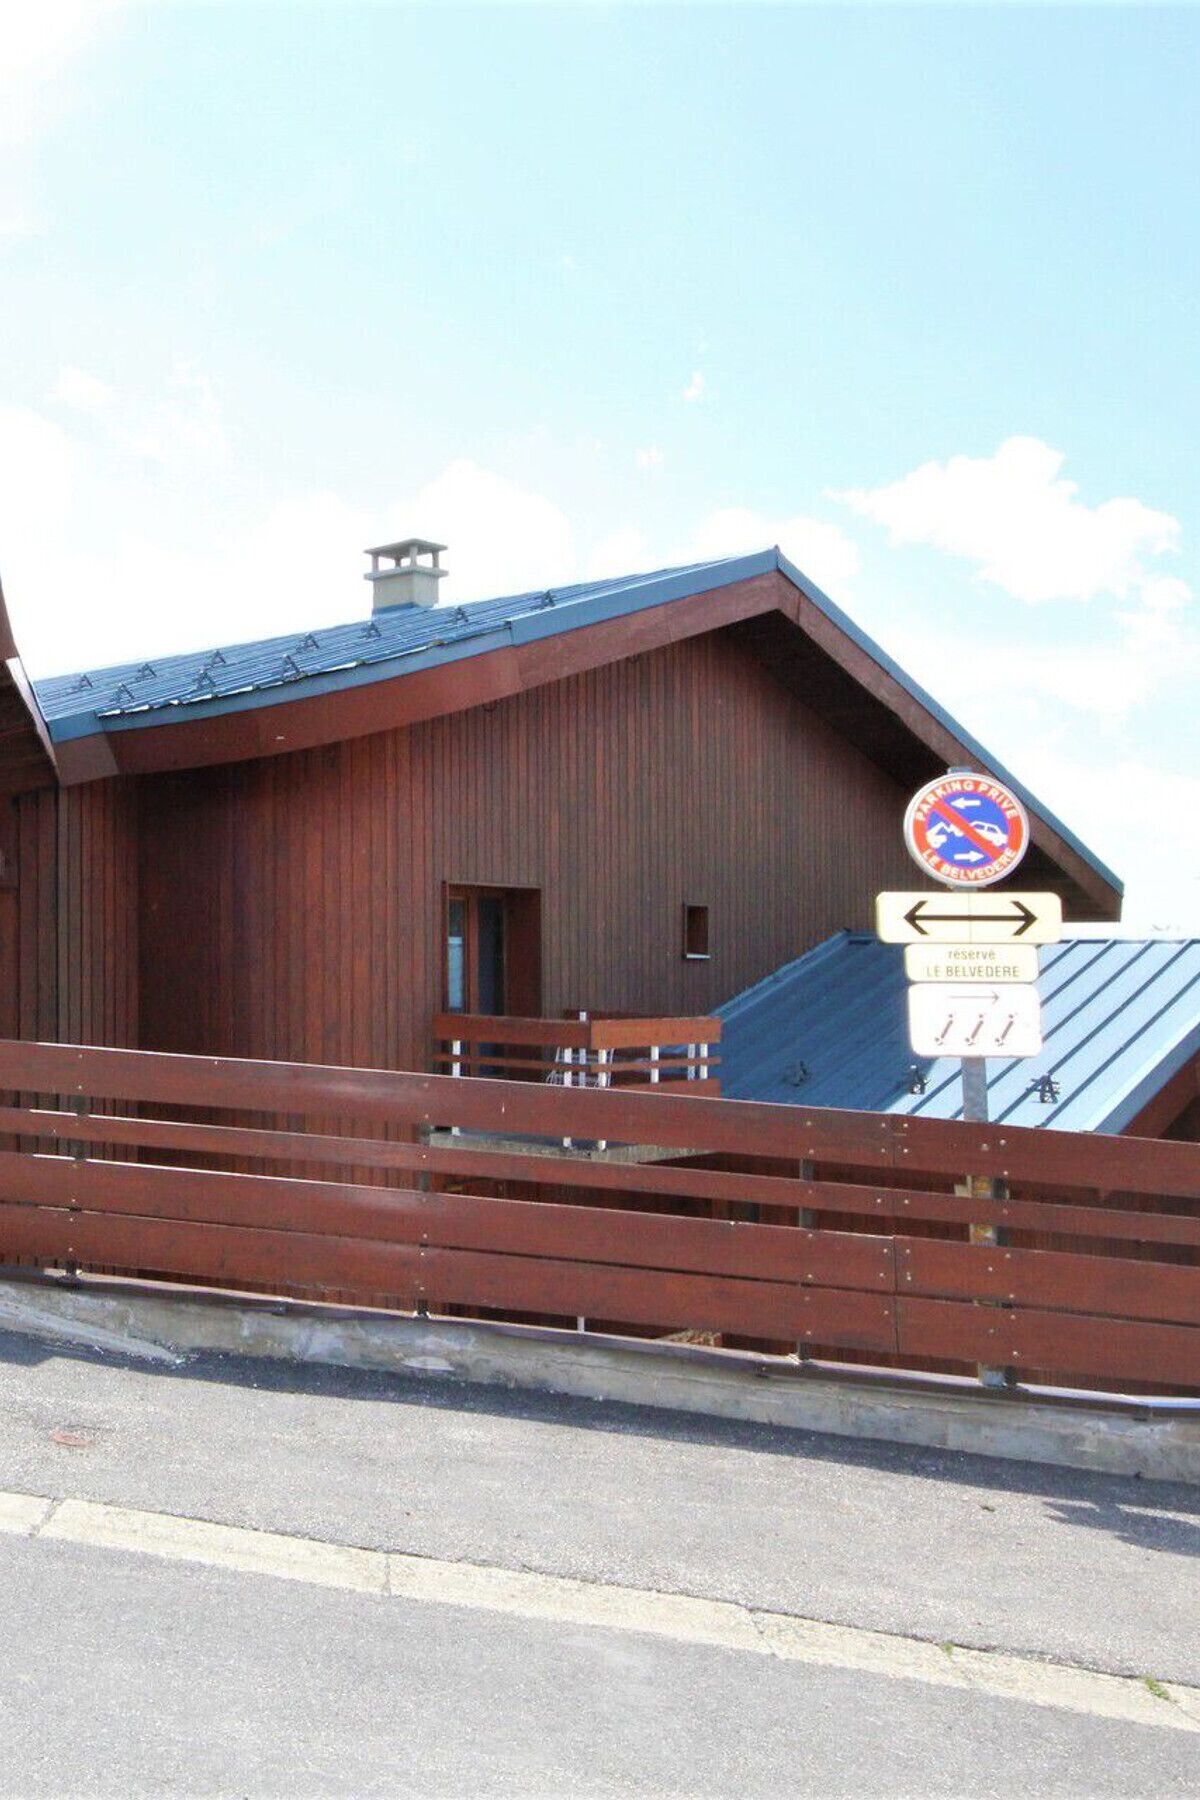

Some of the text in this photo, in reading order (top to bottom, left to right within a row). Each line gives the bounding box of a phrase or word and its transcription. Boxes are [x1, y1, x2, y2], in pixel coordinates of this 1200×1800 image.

[915, 781, 974, 821] PARKING
[922, 848, 940, 868] LE
[926, 966, 941, 977] LE
